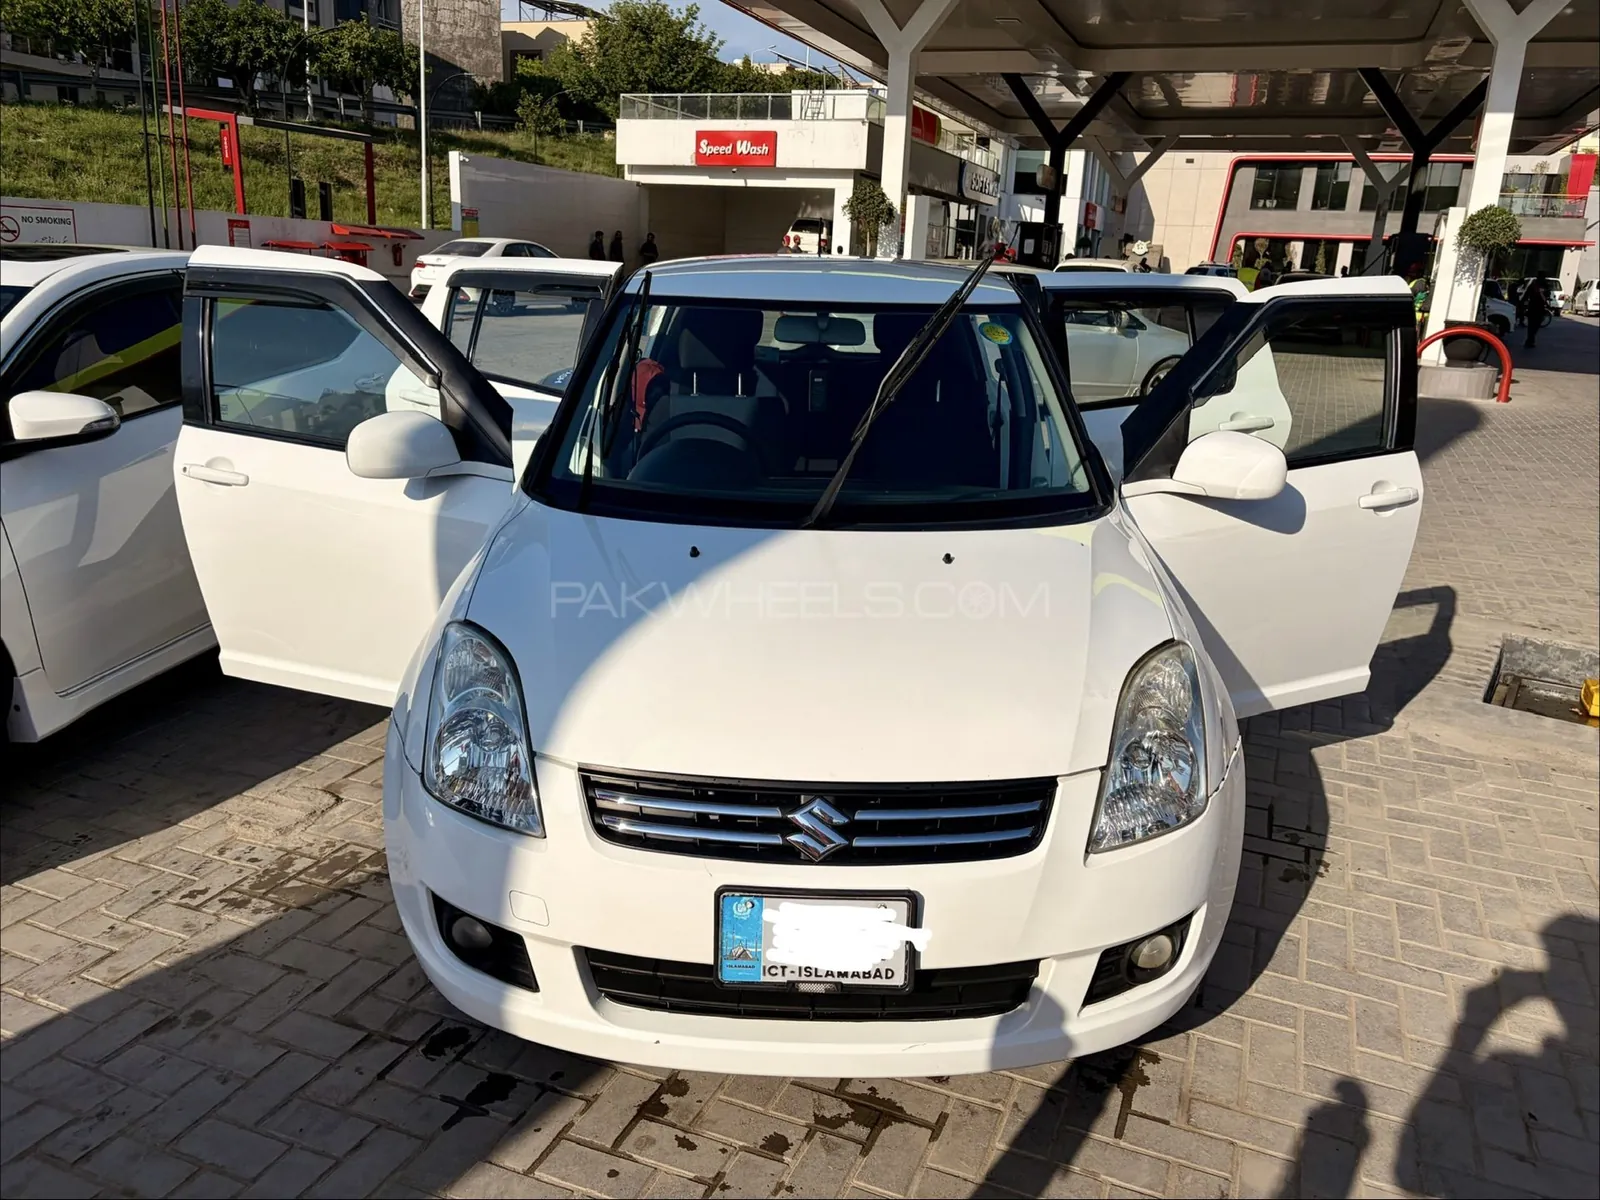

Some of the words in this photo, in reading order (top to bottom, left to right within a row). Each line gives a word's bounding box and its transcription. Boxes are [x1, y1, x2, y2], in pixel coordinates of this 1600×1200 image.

[699, 139, 733, 157] Speed
[736, 140, 769, 155] Wash
[36, 216, 72, 225] SMOKING
